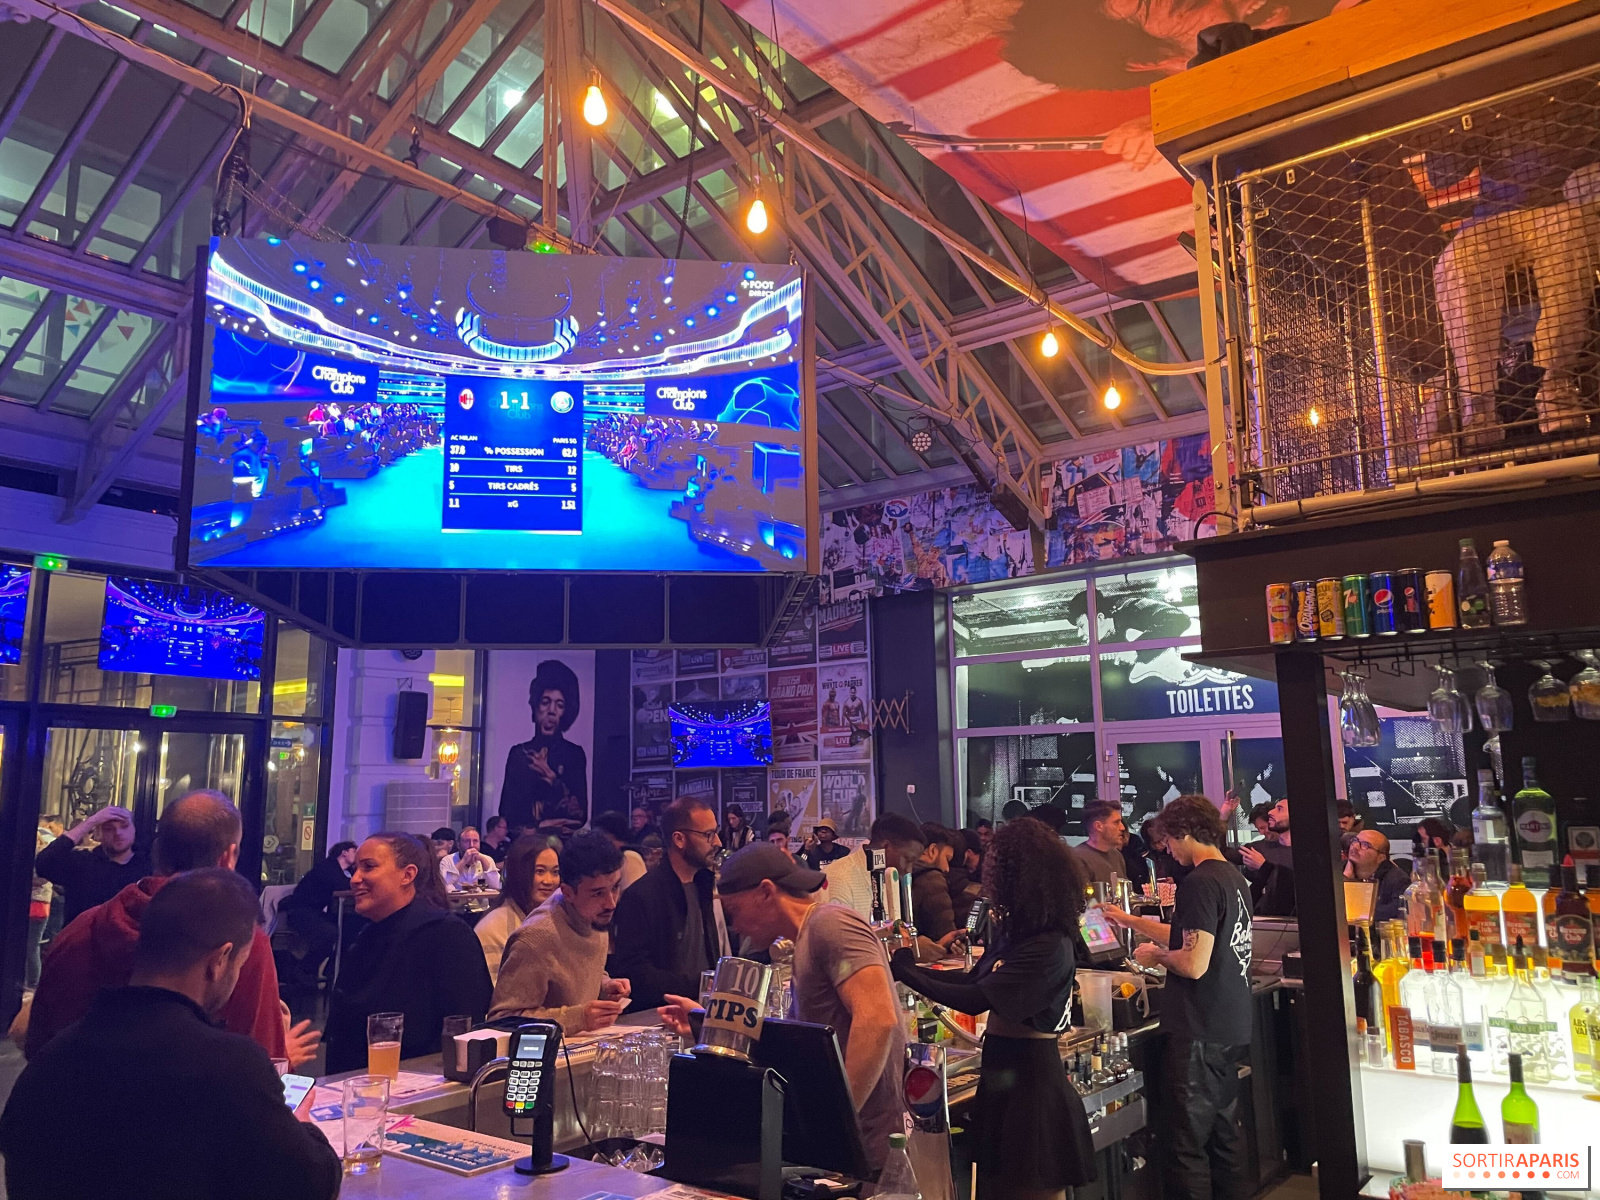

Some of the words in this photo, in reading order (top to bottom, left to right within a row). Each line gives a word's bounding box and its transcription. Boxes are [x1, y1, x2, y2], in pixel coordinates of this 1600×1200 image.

[312, 365, 366, 384] Champions
[330, 380, 354, 394] Club
[656, 386, 707, 399] Champions
[672, 398, 695, 411] Club
[495, 447, 545, 457] POSSESSION
[504, 465, 523, 473] TIRS
[488, 482, 506, 491] TIRS
[507, 481, 540, 492] CADRÉS
[819, 601, 864, 625] MADNESS
[833, 644, 850, 653] LIVE
[750, 653, 765, 661] LIVE
[771, 685, 795, 698] GRAND
[796, 684, 815, 697] PRIX
[1166, 684, 1254, 714] TOILETTES
[771, 769, 786, 779] TOUR
[787, 769, 794, 778] DE
[794, 768, 817, 778] FRANCE
[823, 775, 866, 789] WORLD
[832, 789, 857, 802] CUP
[1520, 822, 1550, 830] MARTINI
[874, 854, 885, 866] IPA
[729, 963, 760, 995] 10
[705, 998, 759, 1028] TIPS
[1397, 1015, 1412, 1063] TABASCO
